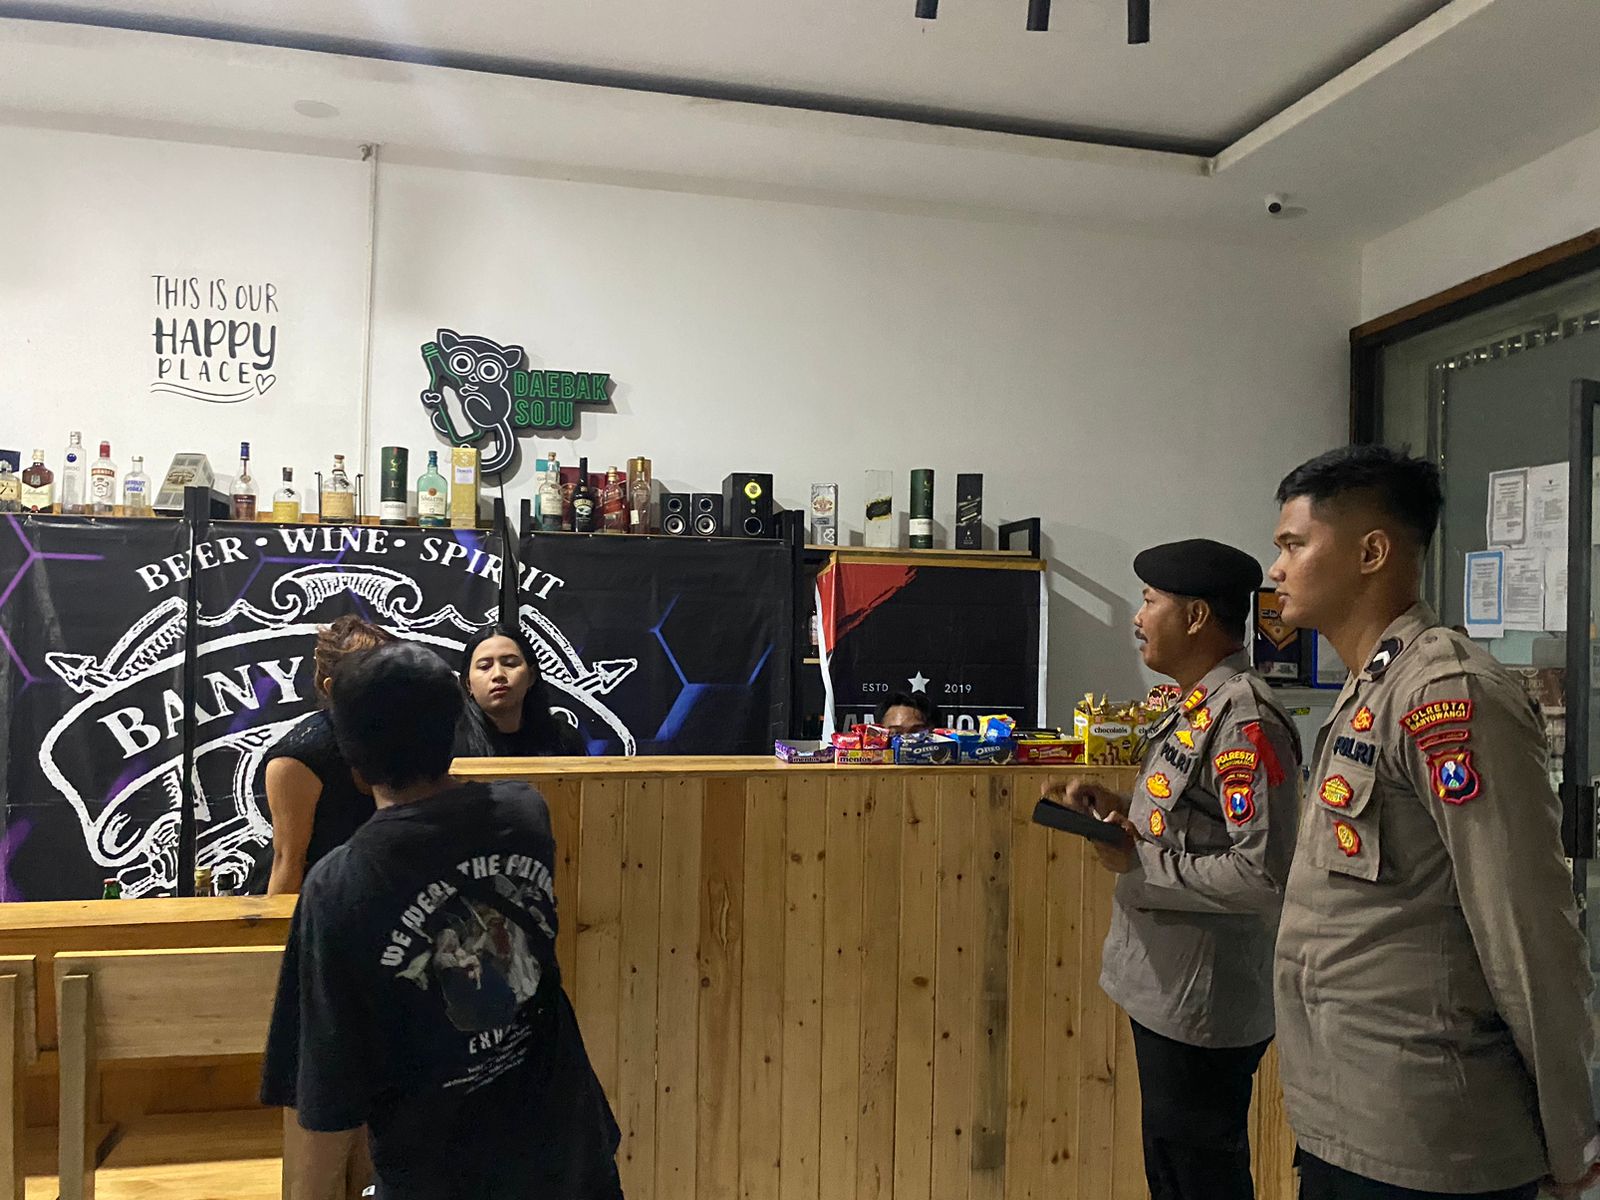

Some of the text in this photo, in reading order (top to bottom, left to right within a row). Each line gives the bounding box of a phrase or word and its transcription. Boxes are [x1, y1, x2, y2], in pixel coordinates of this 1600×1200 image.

[152, 275, 278, 313] THIS IS OUR
[158, 357, 251, 384] PLACE
[514, 371, 608, 400] DAEBAK
[514, 399, 573, 427] SOJU
[136, 526, 565, 600] BEER WINE SPIRIT
[862, 683, 972, 694] ESTD 2019
[97, 656, 304, 759] BANY
[1405, 703, 1465, 726] POLRESTA
[839, 756, 872, 764] mentos
[1160, 740, 1192, 774] POLRI
[1215, 751, 1255, 767] POLRESTA
[1333, 735, 1376, 766] POLRI
[456, 853, 501, 880] THE
